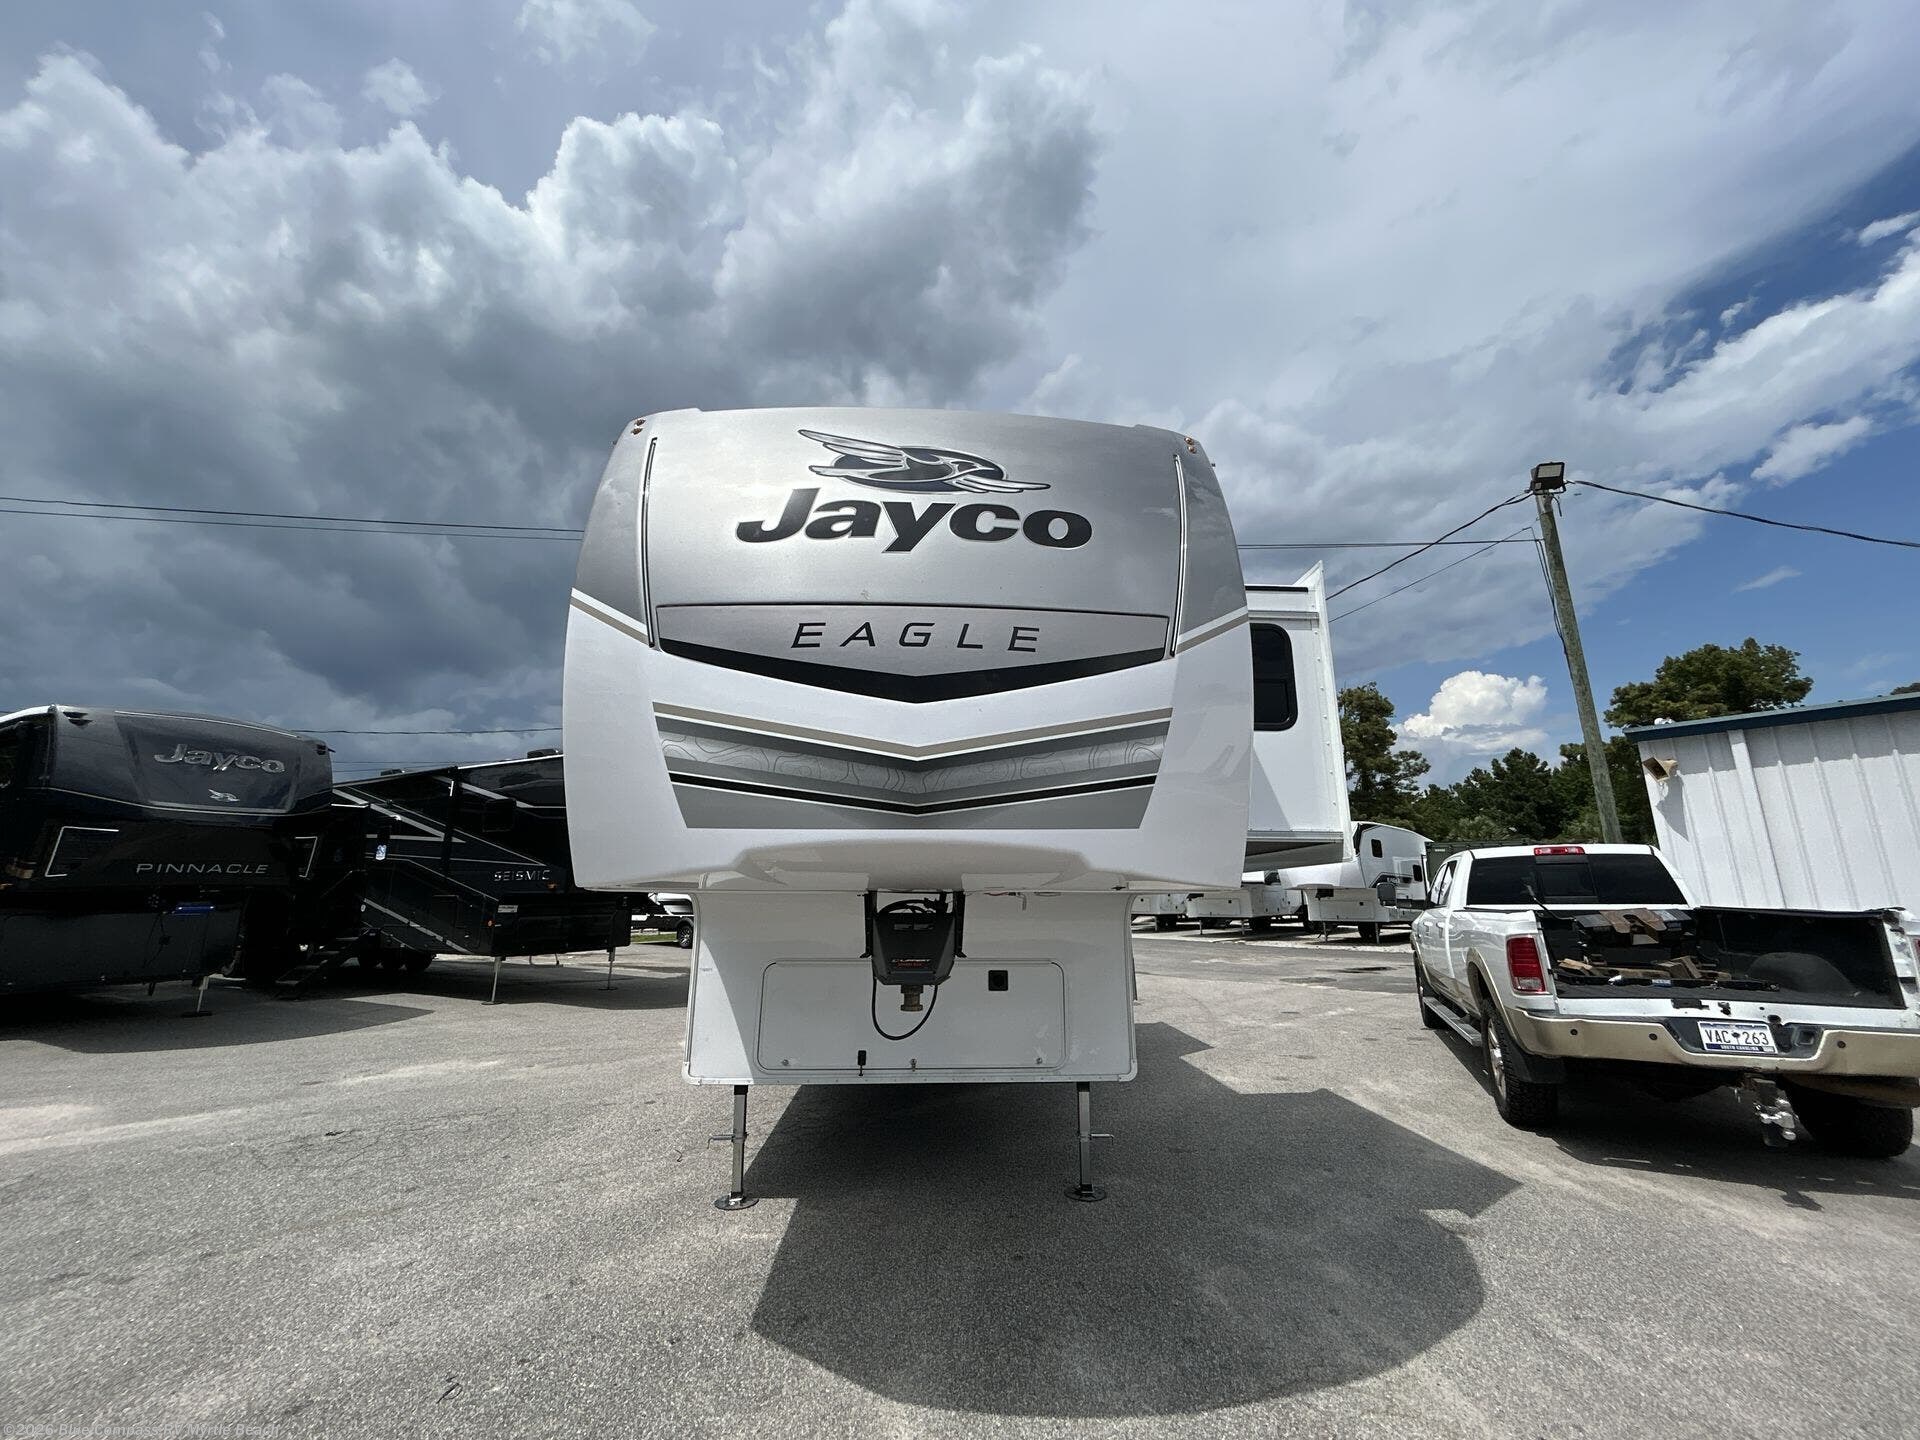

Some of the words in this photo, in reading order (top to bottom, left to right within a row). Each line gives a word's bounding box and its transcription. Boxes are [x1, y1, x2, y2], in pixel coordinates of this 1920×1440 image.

[735, 487, 1093, 553] Jayco
[790, 621, 1040, 652] EAGLE
[154, 743, 286, 774] Jayco
[136, 863, 270, 875] PINNACLE
[494, 870, 551, 881] SEISMIC
[1705, 1030, 1731, 1044] VAC
[1742, 1031, 1769, 1045] 263
